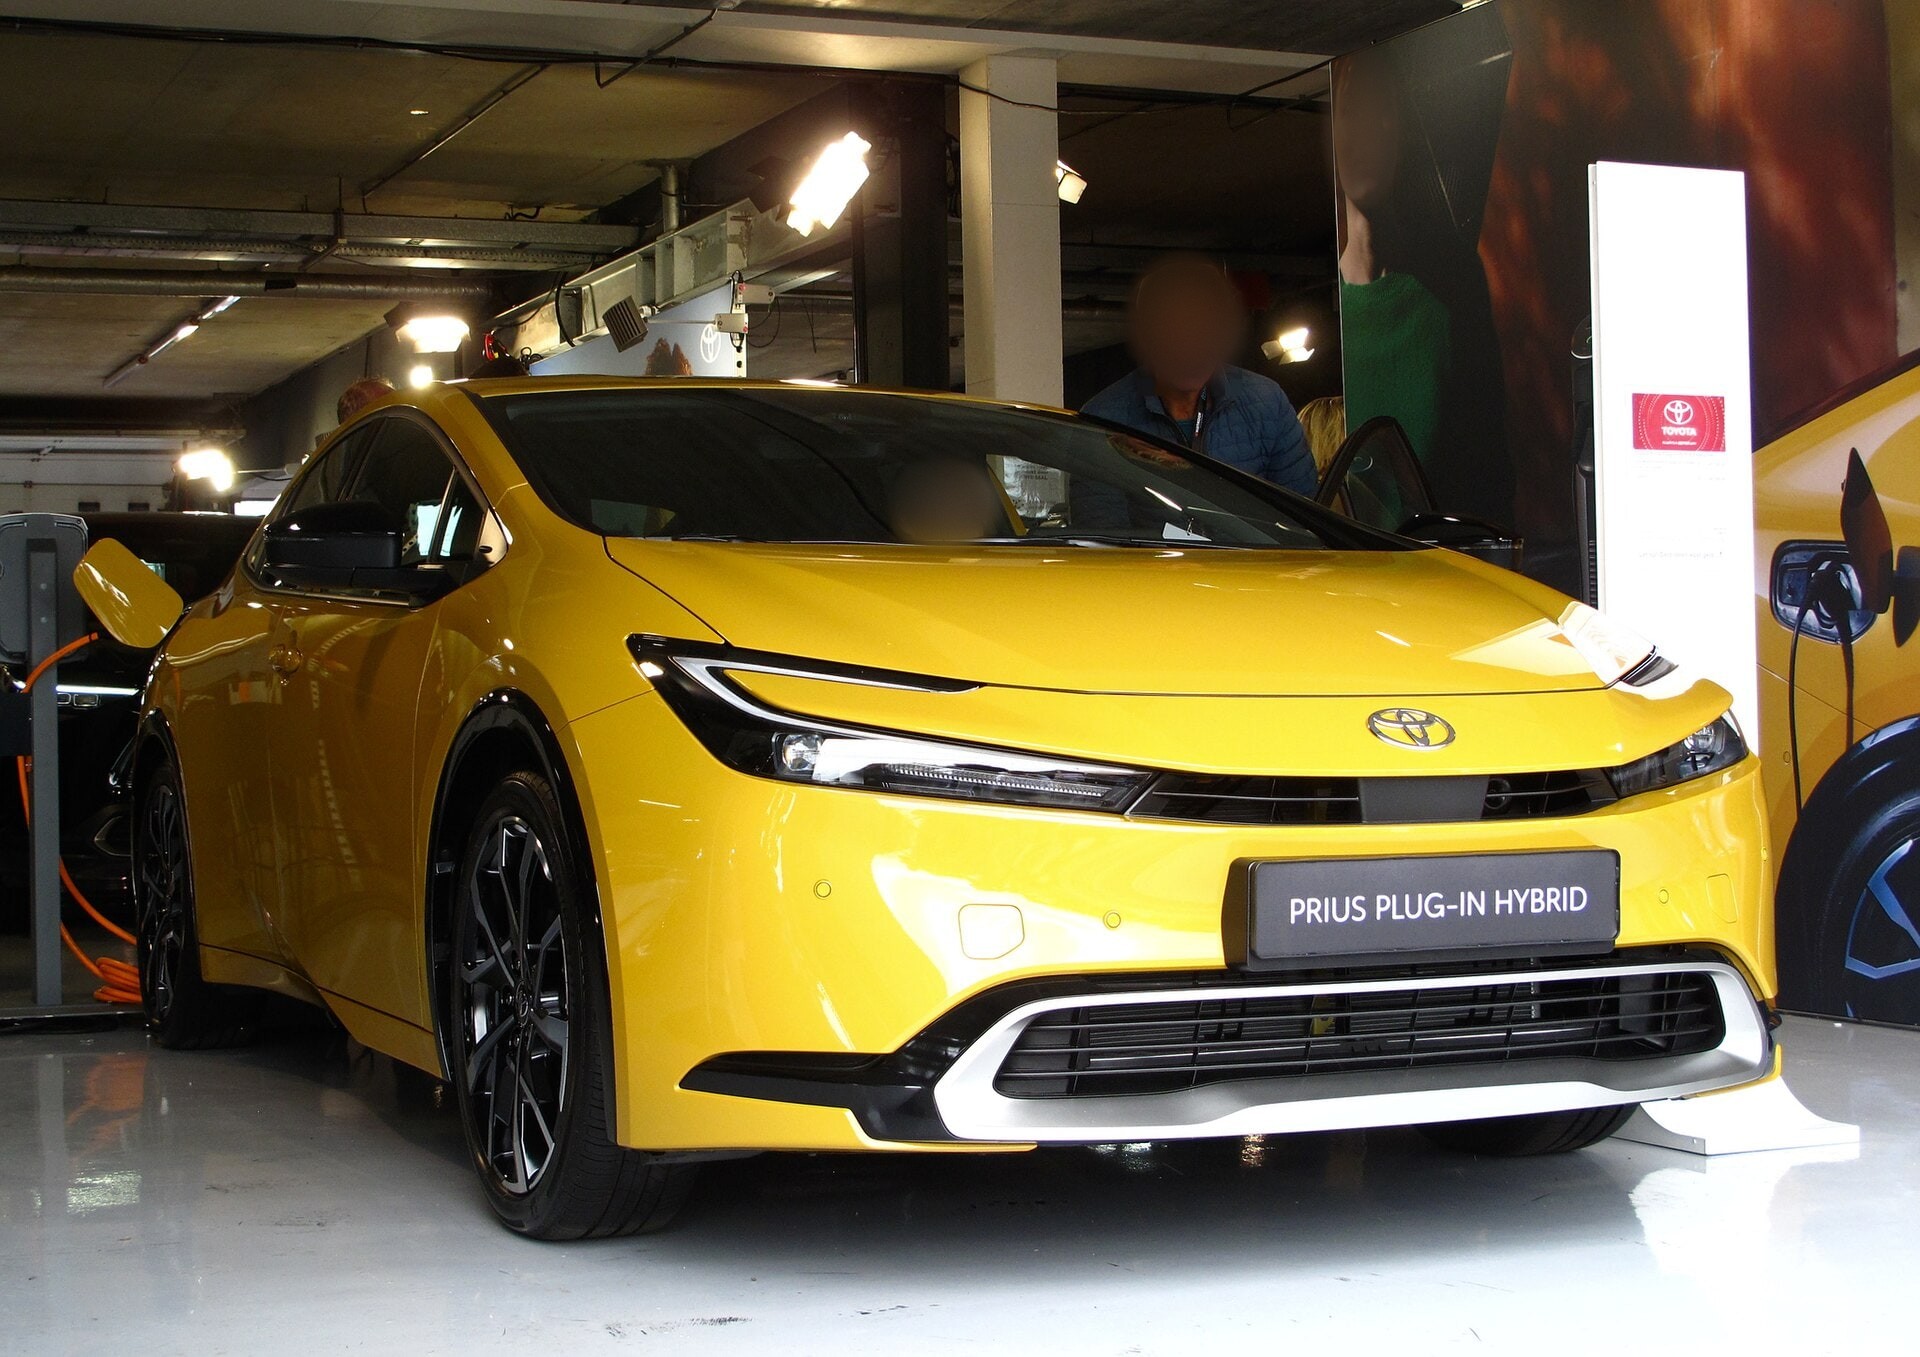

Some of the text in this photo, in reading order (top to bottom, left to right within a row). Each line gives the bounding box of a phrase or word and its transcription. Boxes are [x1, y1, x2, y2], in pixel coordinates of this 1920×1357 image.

[1661, 426, 1697, 436] TOYOTA
[1290, 886, 1588, 925] PRIUS PLUG-IN HYBRID
